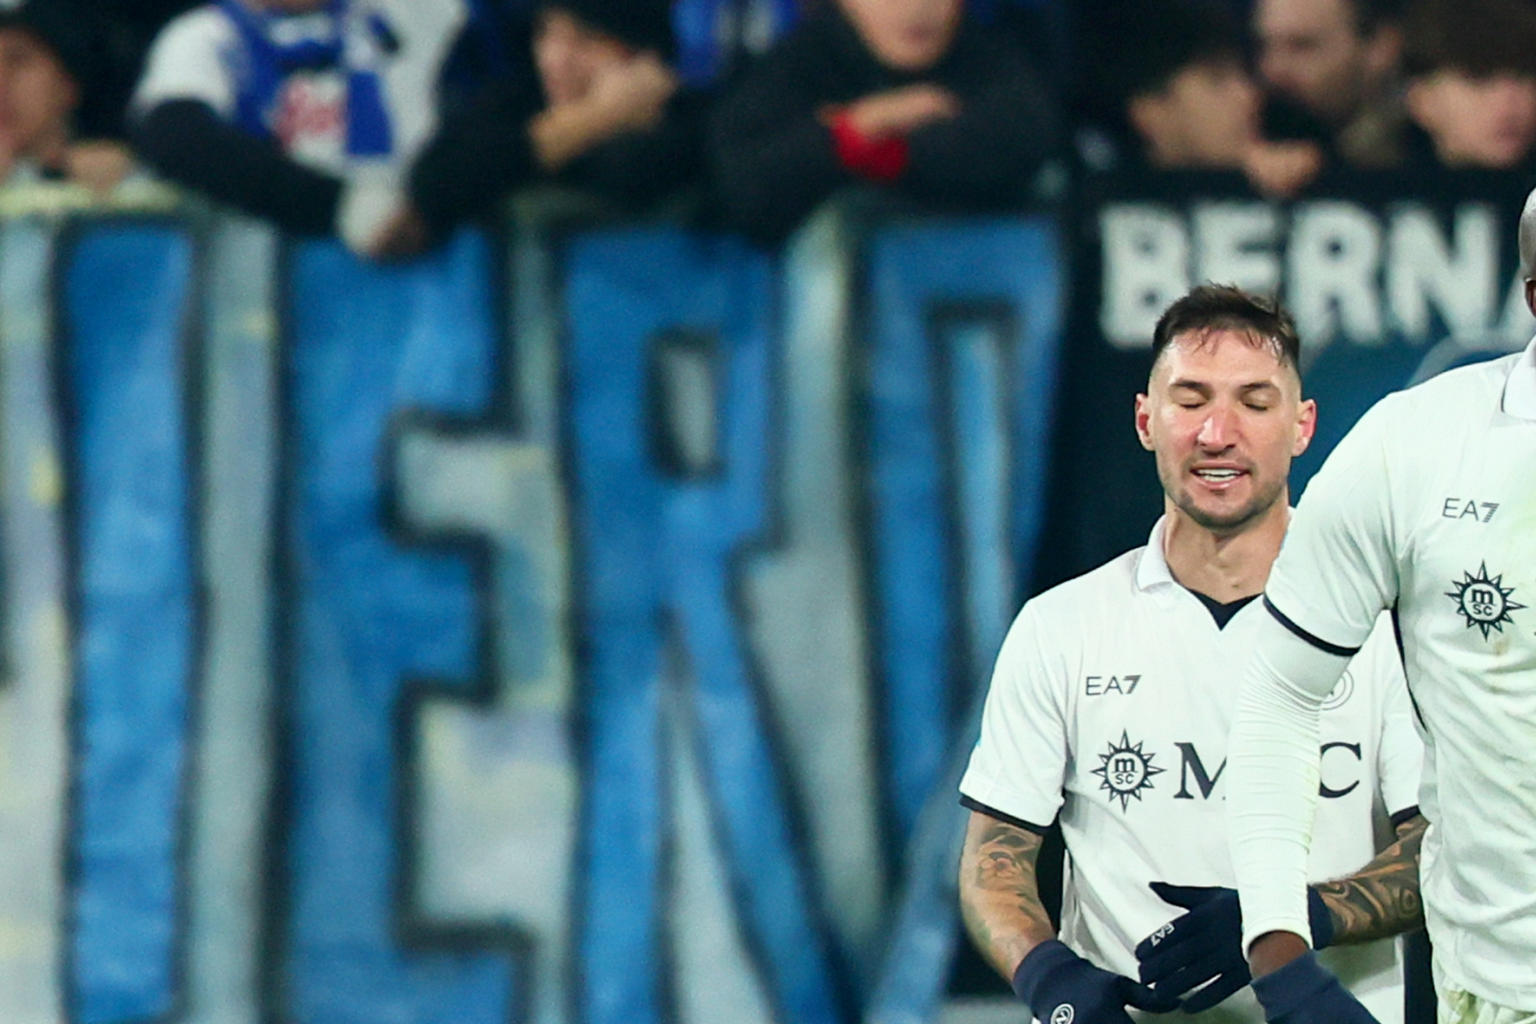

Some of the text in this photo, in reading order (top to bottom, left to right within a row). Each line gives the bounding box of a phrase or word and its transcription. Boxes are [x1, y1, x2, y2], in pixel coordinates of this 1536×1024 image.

[1442, 497, 1499, 523] EA7
[1085, 675, 1142, 696] EA7
[1173, 741, 1362, 800] MC
